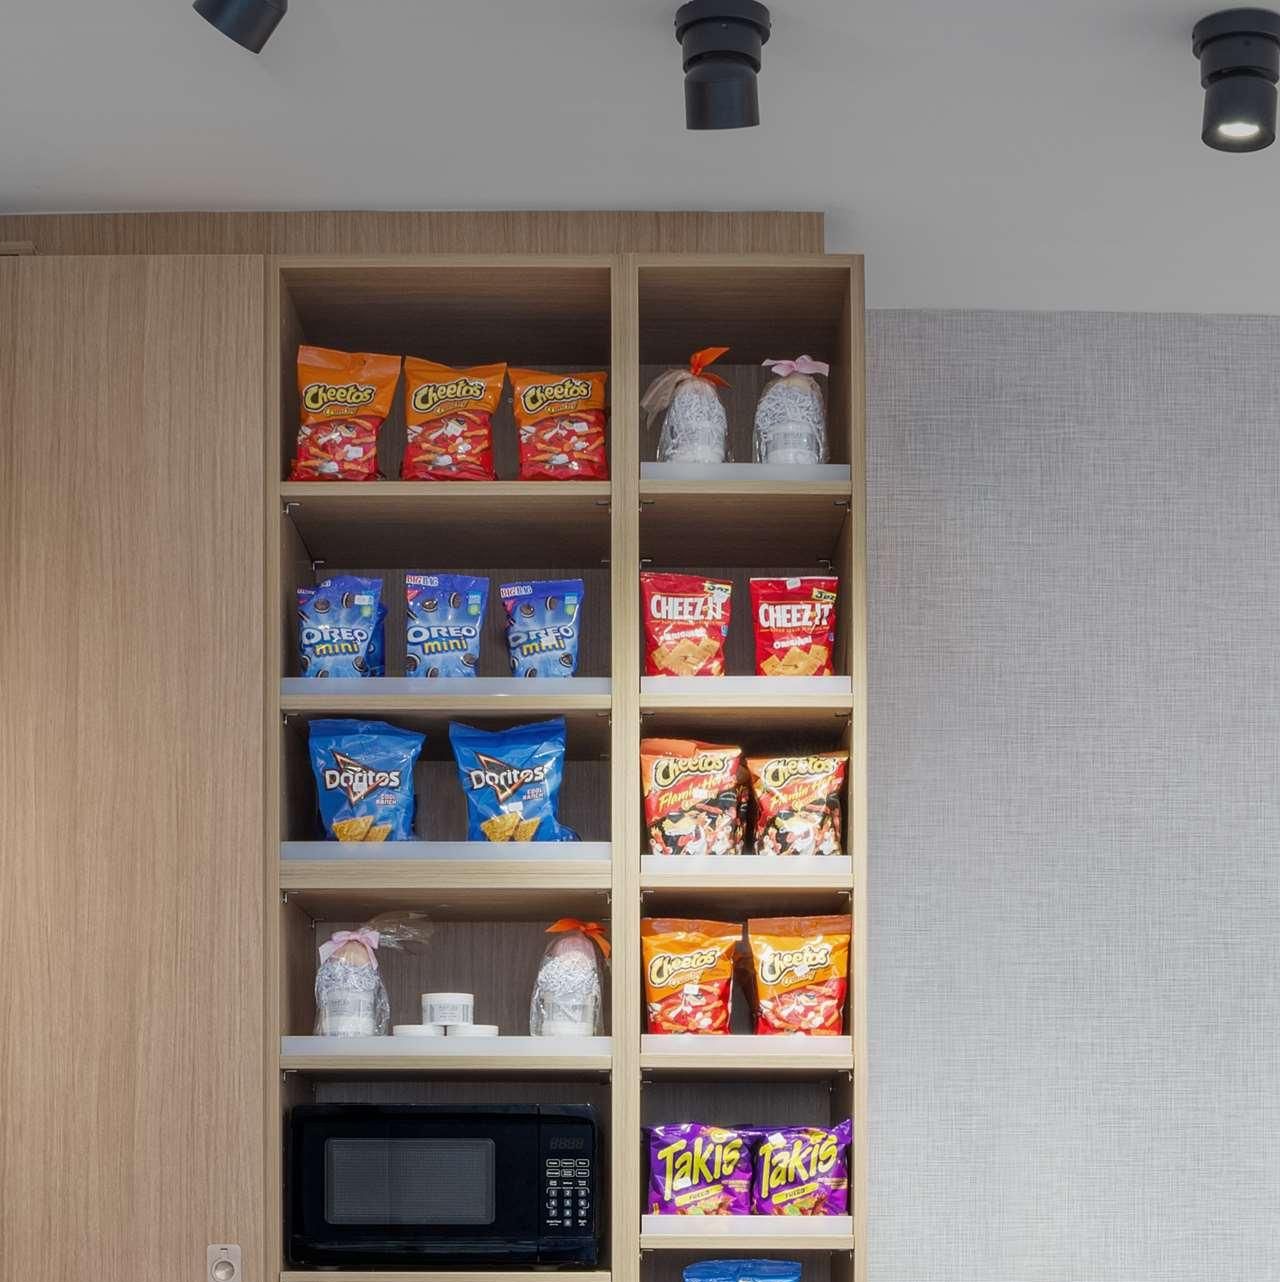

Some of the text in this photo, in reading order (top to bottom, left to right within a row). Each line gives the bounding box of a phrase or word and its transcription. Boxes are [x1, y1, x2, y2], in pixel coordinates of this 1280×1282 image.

[303, 384, 374, 411] Cheetos
[413, 378, 484, 413] Cheetos
[521, 378, 592, 414] Cheetos
[302, 625, 369, 645] OREO
[313, 640, 360, 656] mini
[407, 624, 477, 644] OREO
[422, 638, 469, 654] mini
[470, 764, 547, 790] Doritos
[652, 755, 728, 789] Cheetos
[649, 948, 720, 987] Cheetos
[760, 946, 831, 985] Cheetos
[657, 1136, 744, 1201] Takis
[758, 1134, 839, 1199] Takis
